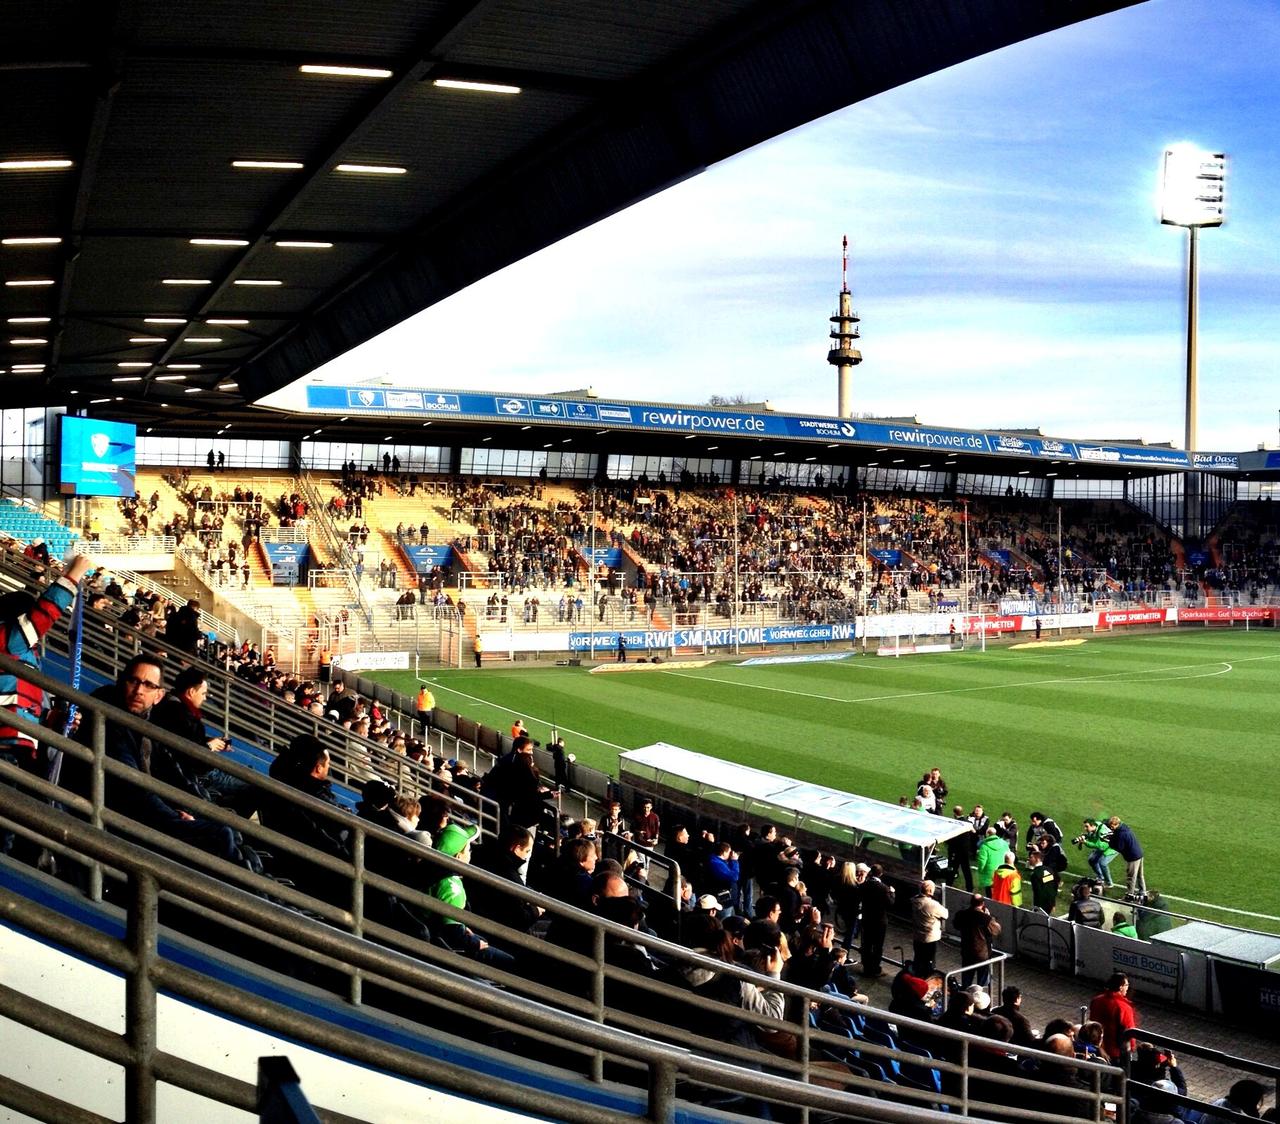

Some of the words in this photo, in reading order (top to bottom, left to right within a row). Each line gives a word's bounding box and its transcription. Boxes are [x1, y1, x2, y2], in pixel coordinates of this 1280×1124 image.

[642, 410, 765, 432] rewirpower.de
[799, 420, 838, 430] STADTWERKE
[889, 428, 982, 449] rewirpower.de
[1194, 454, 1212, 463] Bad
[1215, 455, 1237, 463] Oase
[1128, 612, 1161, 621] SPORTWETTEN
[1231, 610, 1241, 618] für
[570, 634, 617, 647] VORWEG
[645, 631, 674, 648] RWE
[681, 627, 767, 646] SMARTHOME
[770, 629, 809, 640] VORWEG
[809, 628, 831, 638] GEHEN
[1112, 951, 1138, 966] Stadt
